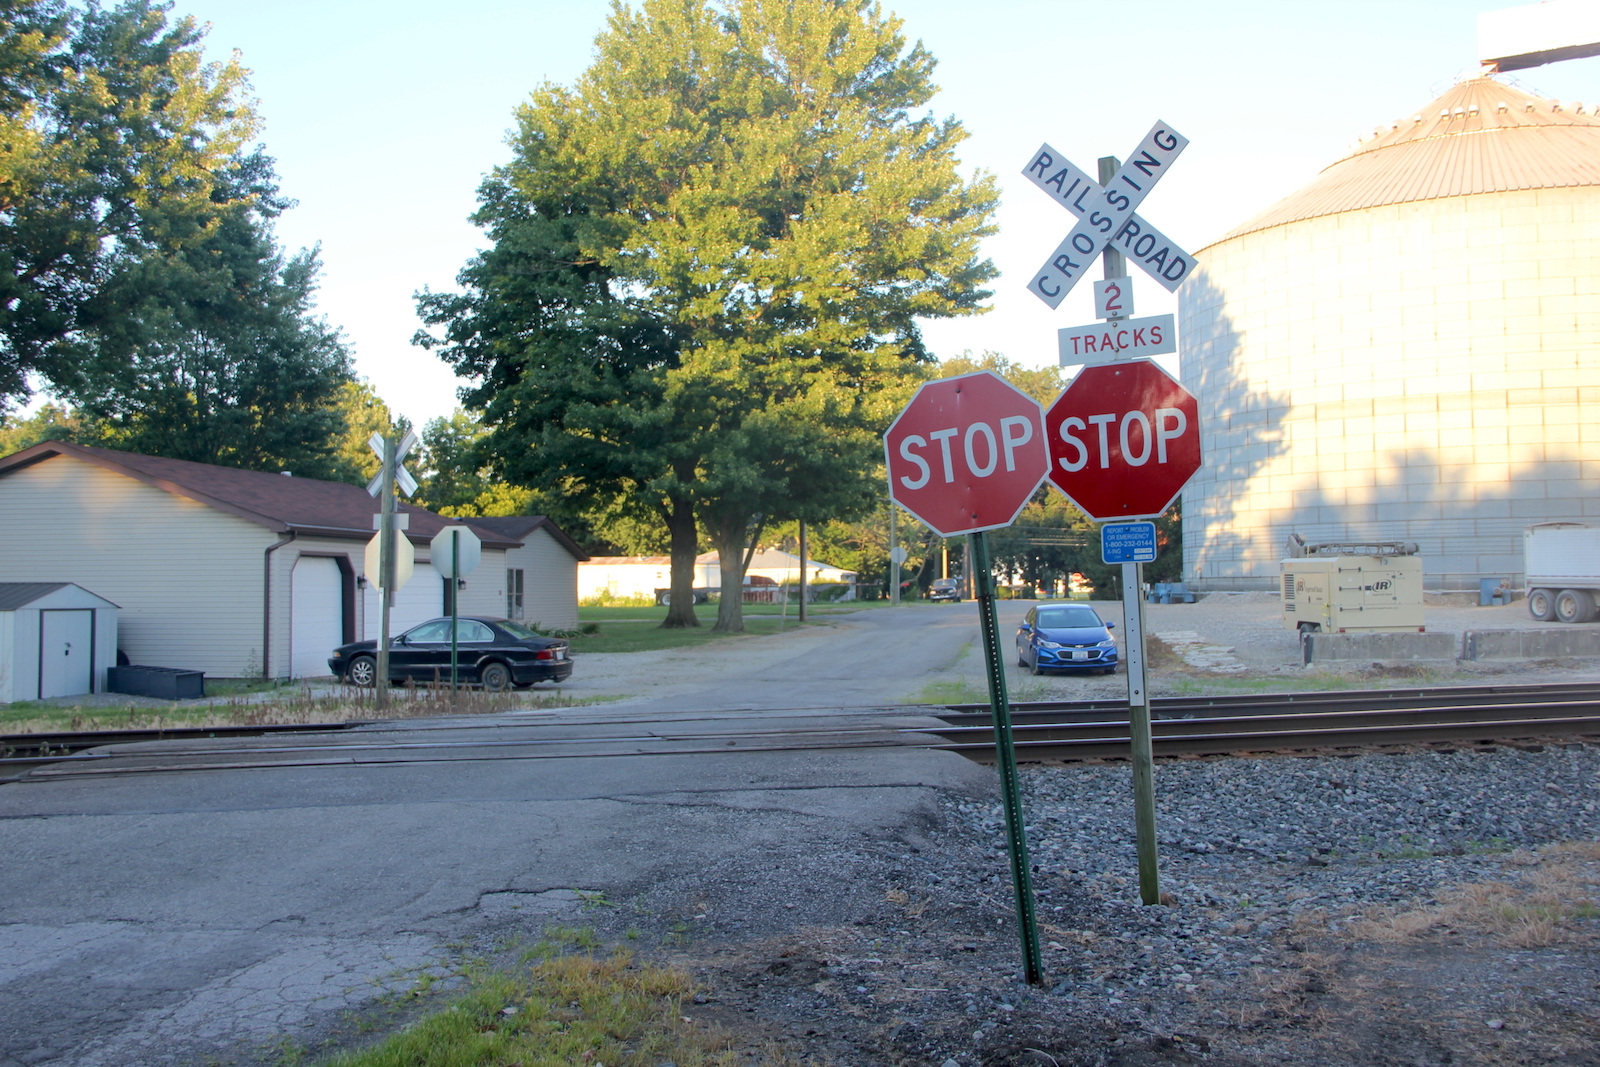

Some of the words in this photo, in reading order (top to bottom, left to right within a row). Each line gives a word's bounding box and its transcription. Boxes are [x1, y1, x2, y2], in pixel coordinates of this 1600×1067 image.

[1029, 151, 1091, 213] RAIL
[1115, 219, 1187, 282] ROAD
[1037, 129, 1178, 298] CROSSING
[1104, 285, 1122, 311] 2
[1070, 326, 1163, 355] TRACKS
[899, 415, 1033, 490] STOP
[1058, 407, 1187, 472] STOP
